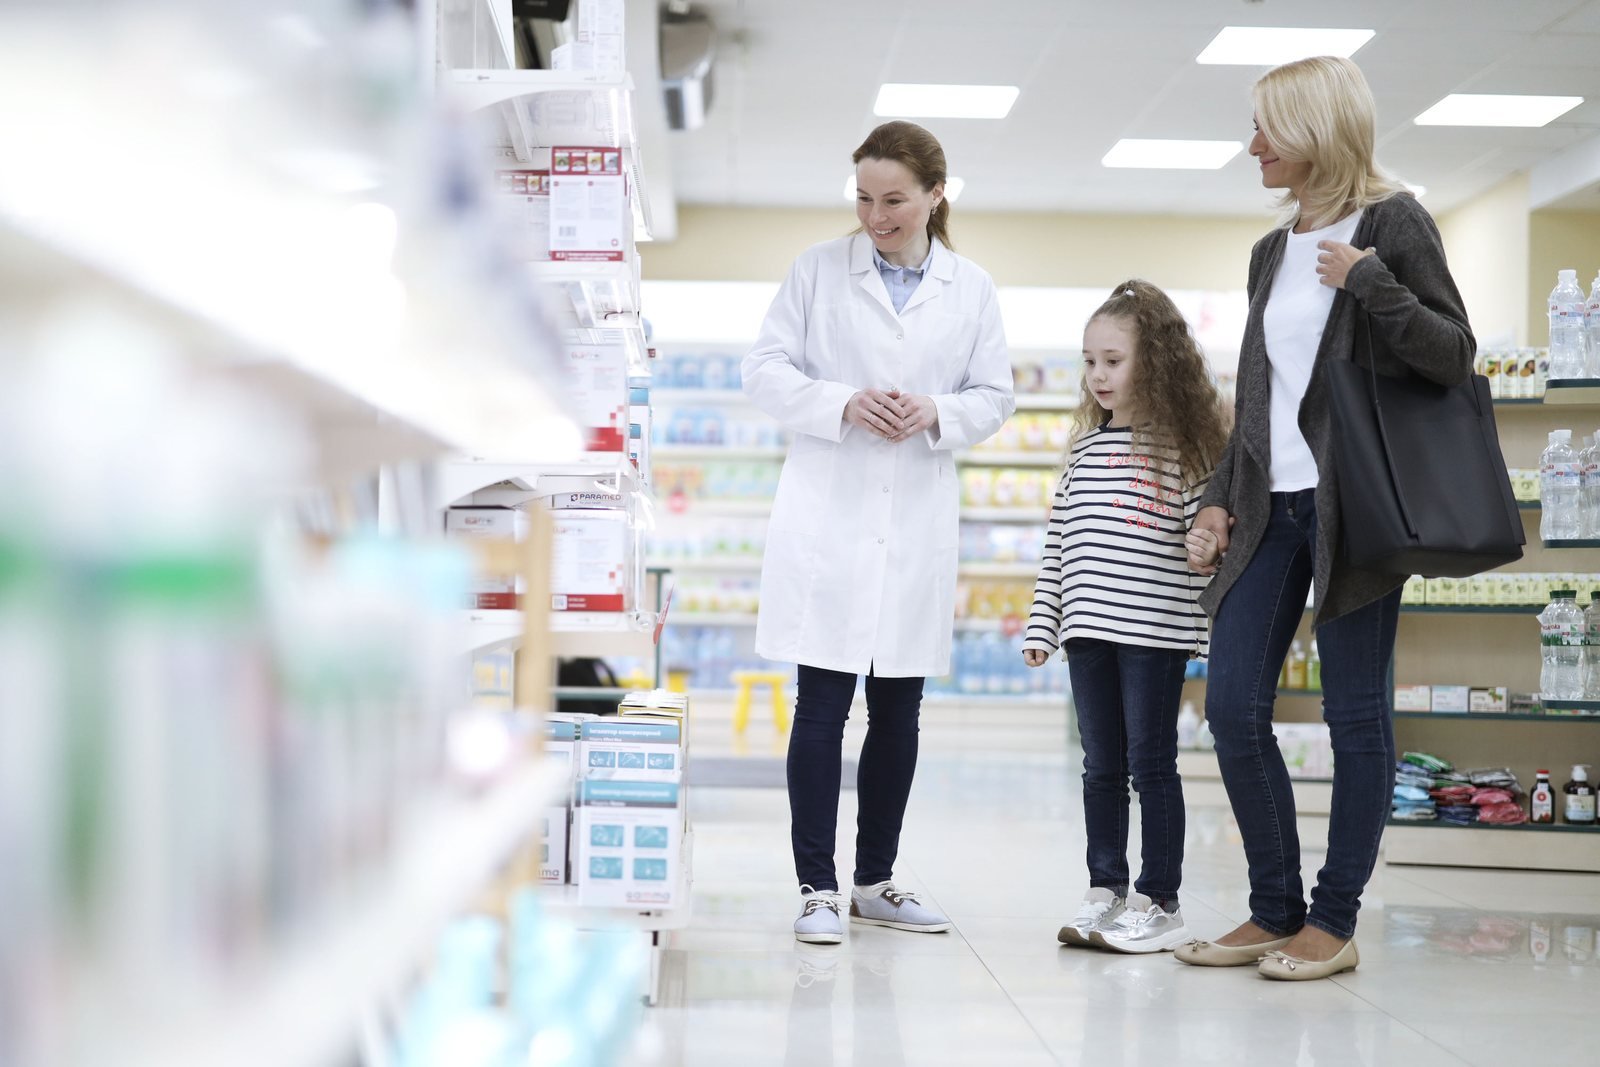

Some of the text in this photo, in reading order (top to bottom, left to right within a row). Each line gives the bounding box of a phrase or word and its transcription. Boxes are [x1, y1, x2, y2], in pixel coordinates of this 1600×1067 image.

[1105, 452, 1149, 471] Every
[1128, 470, 1161, 498] day
[1112, 497, 1126, 507] a
